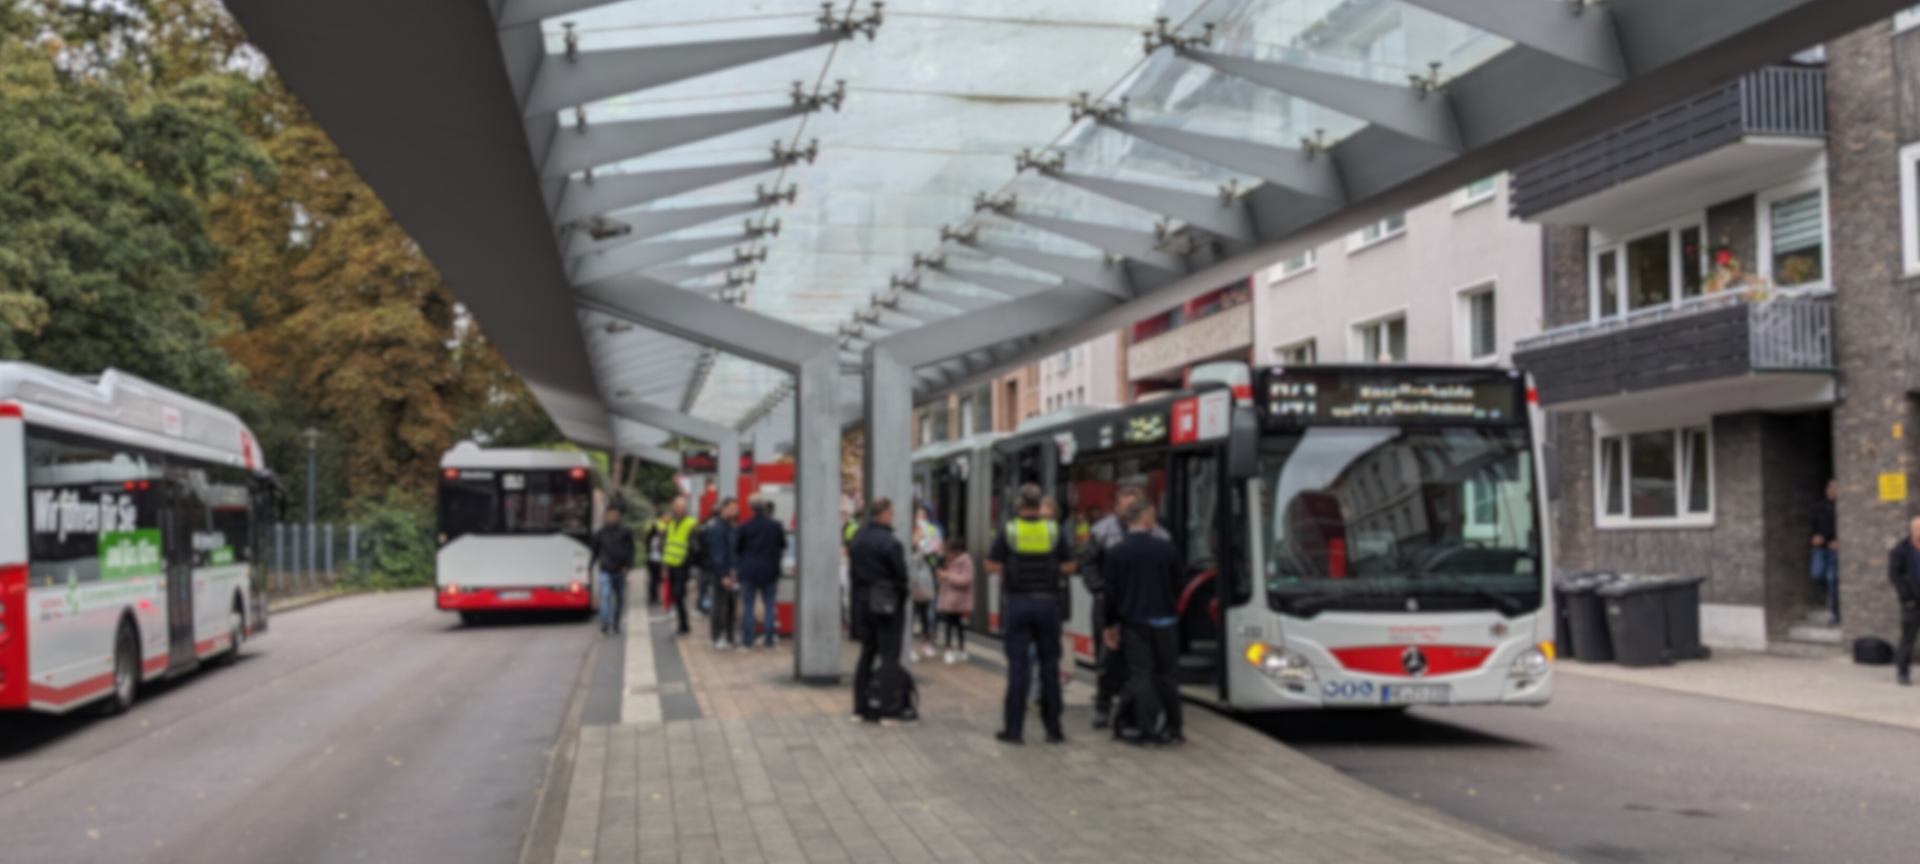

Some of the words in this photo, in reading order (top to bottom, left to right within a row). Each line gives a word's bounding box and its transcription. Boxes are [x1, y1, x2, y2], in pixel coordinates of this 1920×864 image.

[32, 489, 58, 533] Wir
[100, 493, 118, 541] für
[119, 495, 138, 532] Sie
